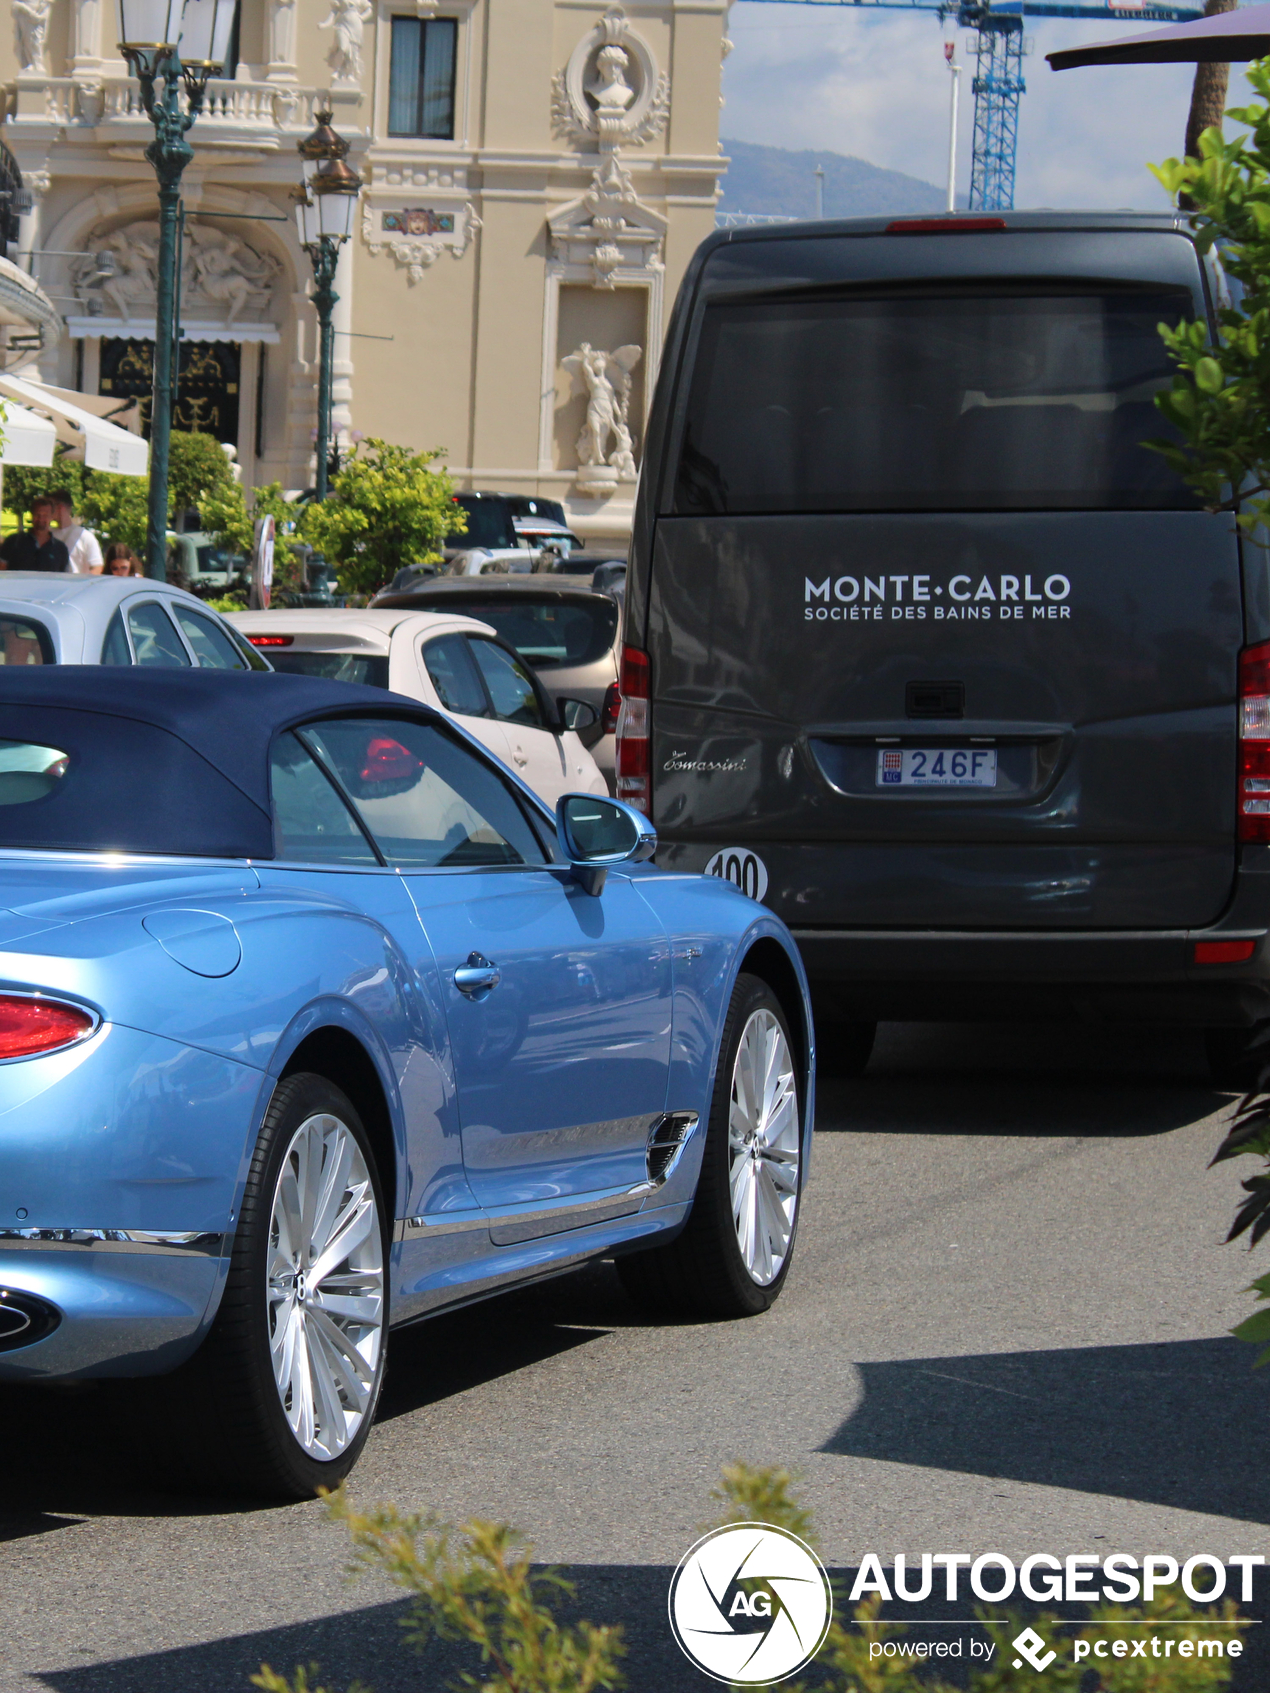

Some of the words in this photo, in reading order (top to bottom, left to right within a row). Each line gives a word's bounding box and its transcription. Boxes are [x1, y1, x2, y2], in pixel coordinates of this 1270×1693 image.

[804, 603, 883, 620] SOCIÉTÉ
[891, 606, 926, 619] DES
[934, 606, 991, 619] BAINS
[999, 606, 1024, 618] DE
[1032, 606, 1071, 618] MER
[911, 751, 988, 778] 246F
[886, 772, 899, 780] MC
